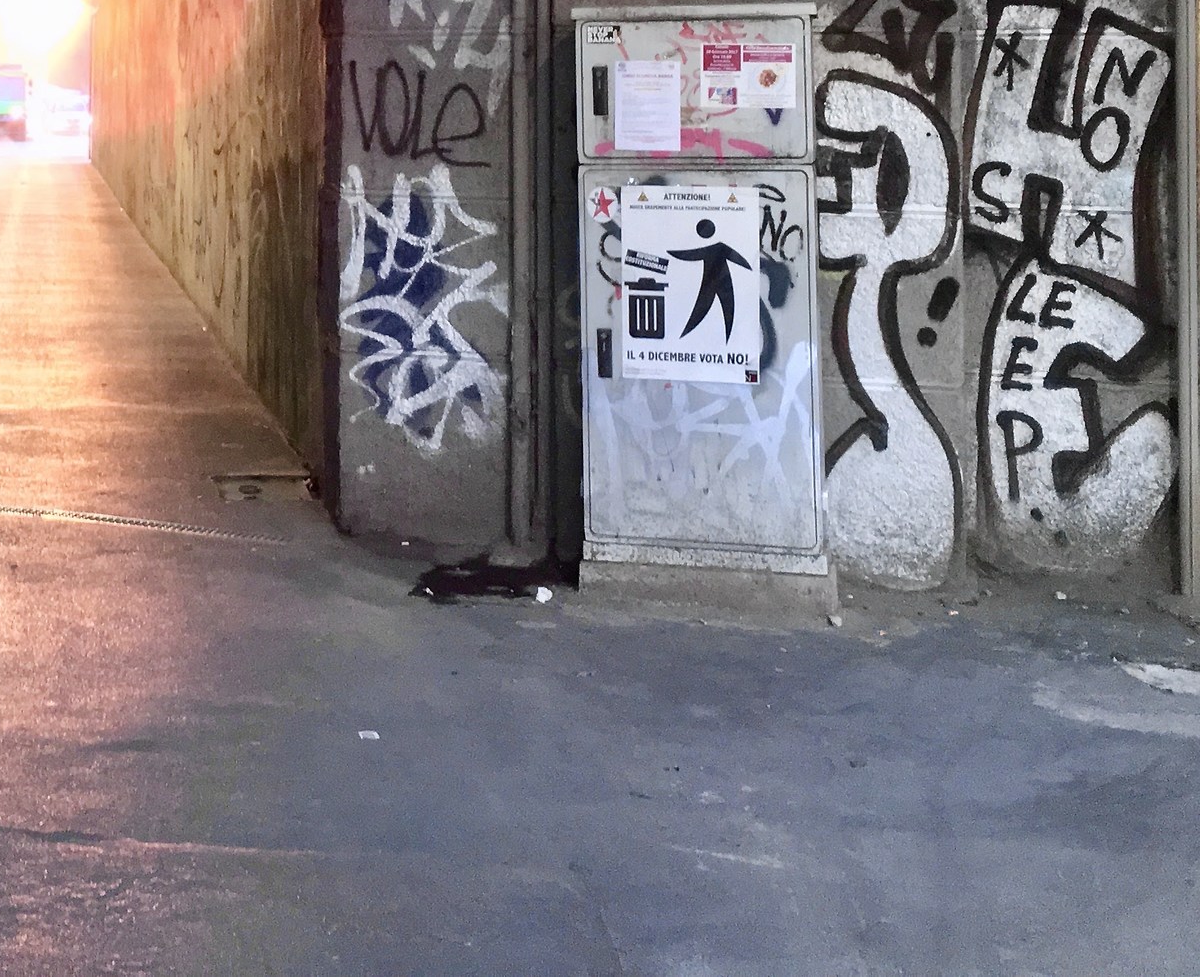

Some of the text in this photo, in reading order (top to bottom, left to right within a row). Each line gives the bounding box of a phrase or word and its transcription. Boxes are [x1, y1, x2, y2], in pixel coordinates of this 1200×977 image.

[663, 192, 711, 201] ATTENZIONE!
[626, 350, 749, 365] IL 4 DICEMBRE VOTA NO!
